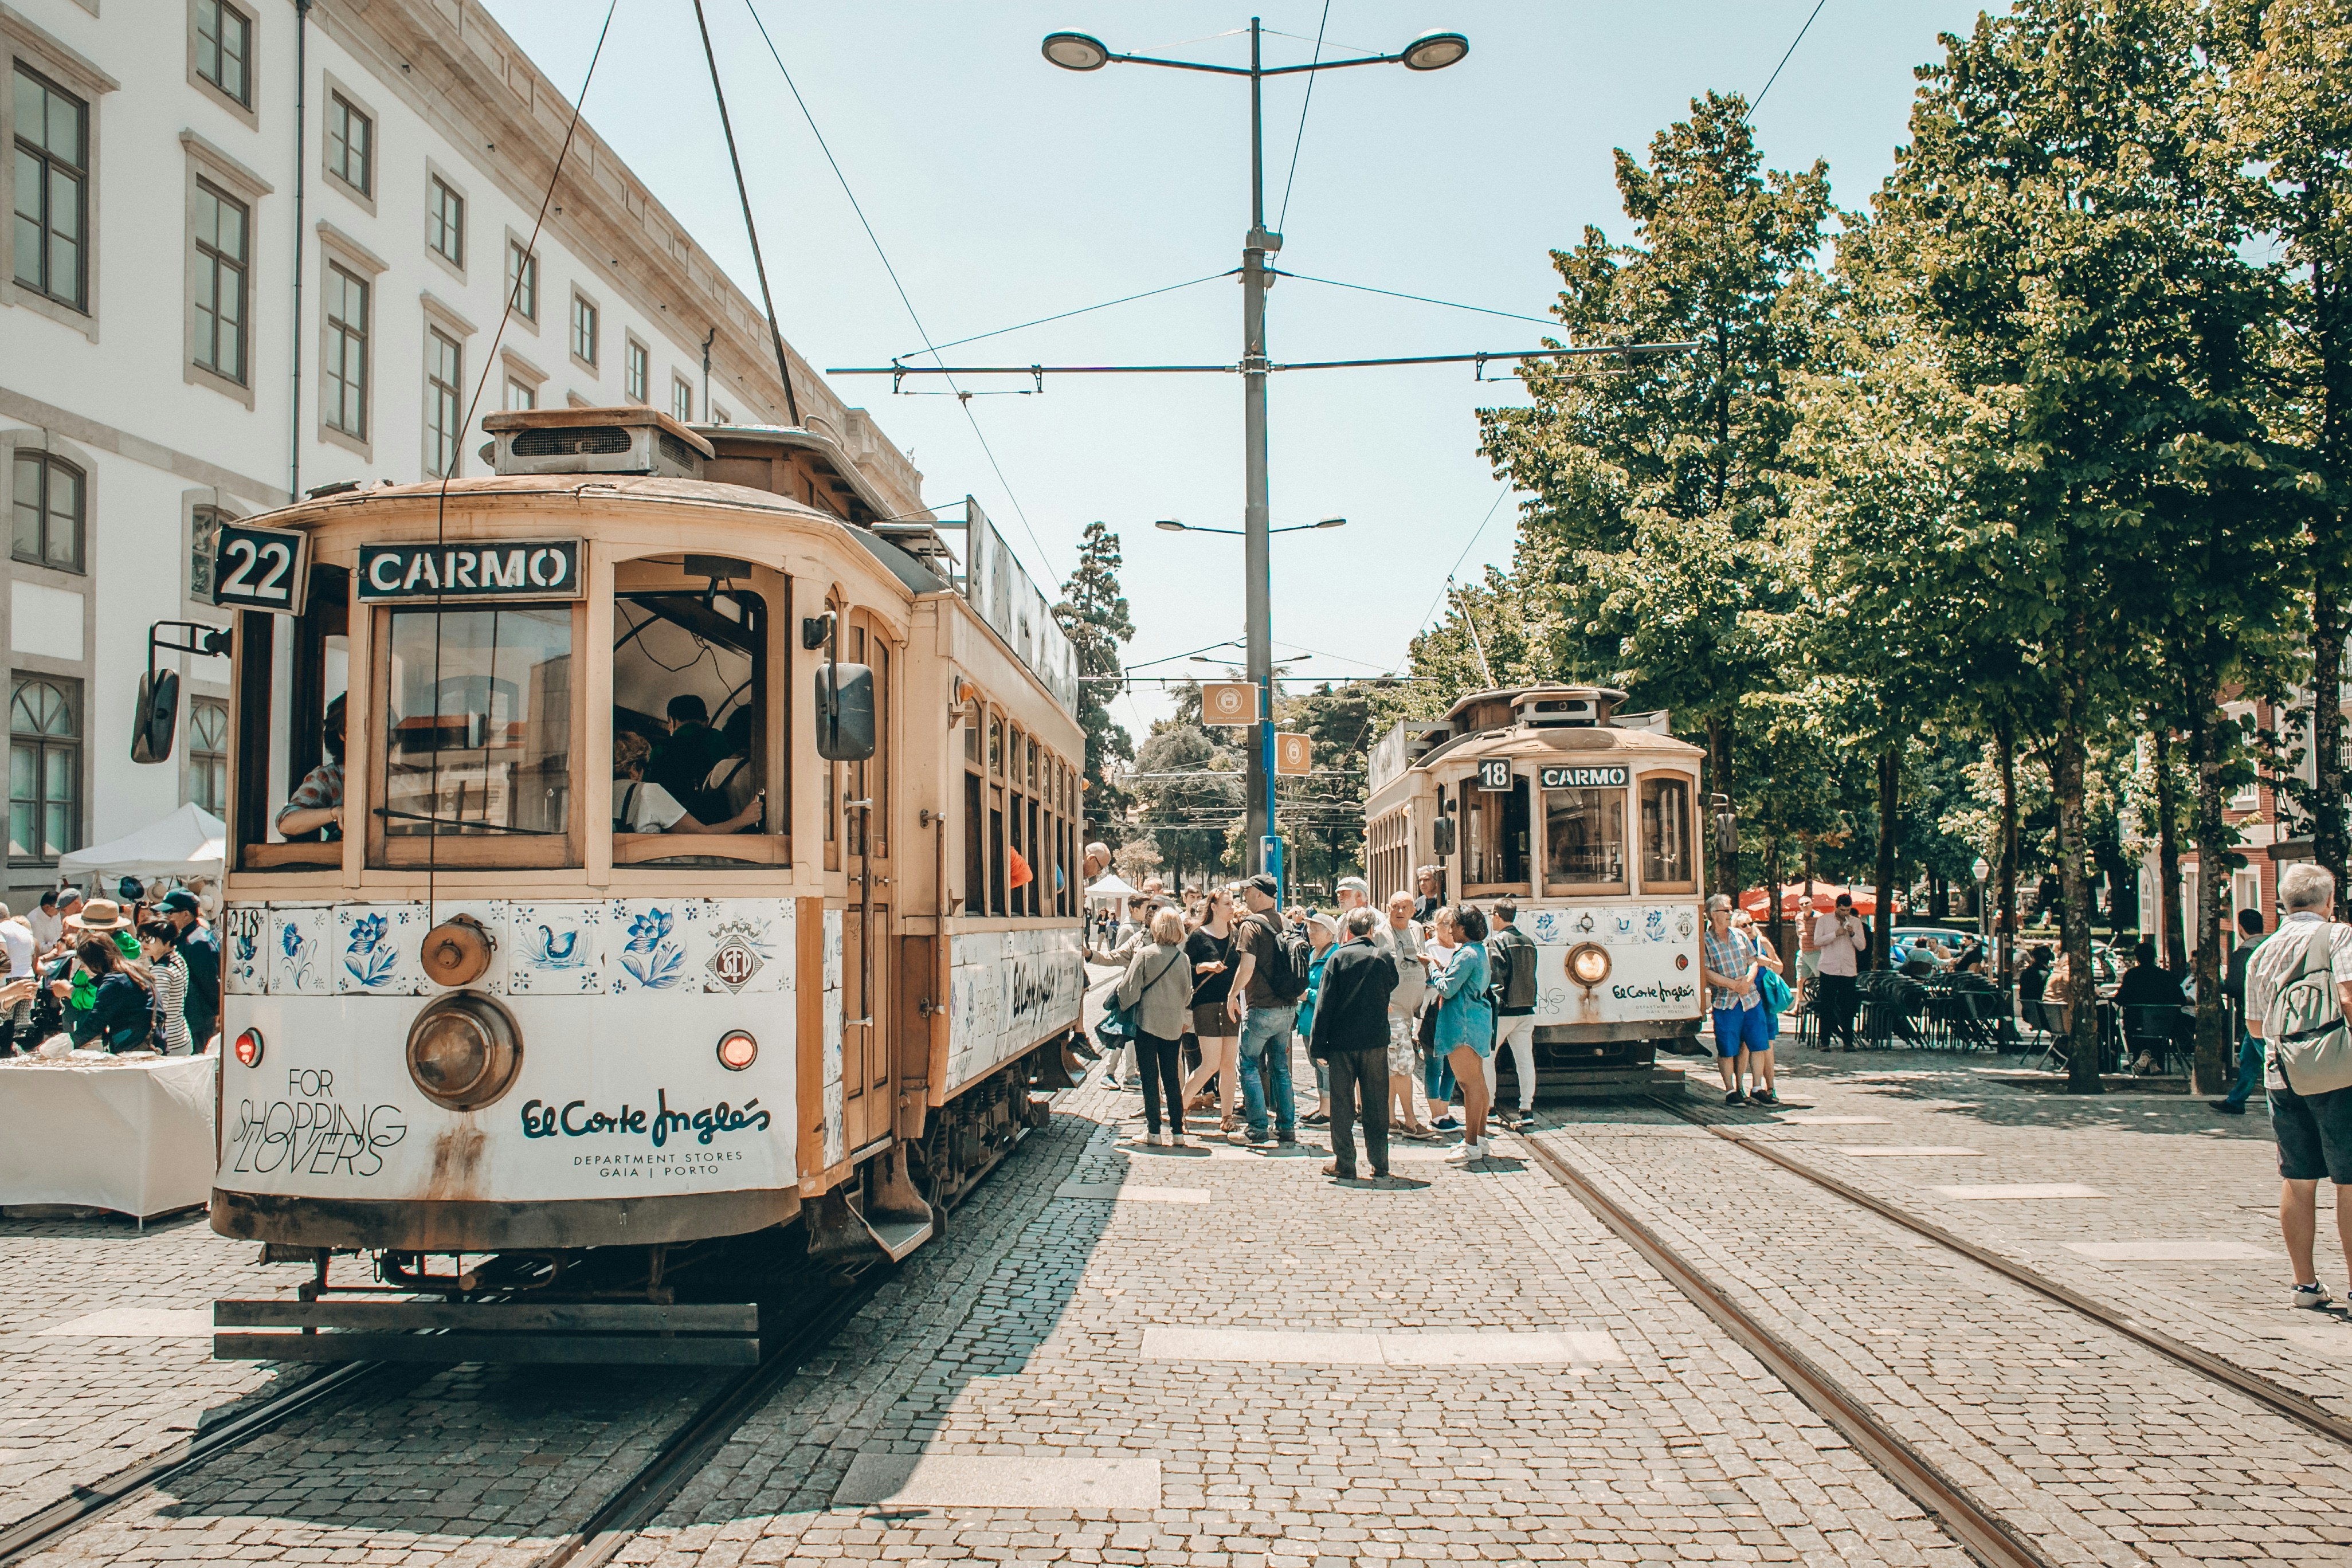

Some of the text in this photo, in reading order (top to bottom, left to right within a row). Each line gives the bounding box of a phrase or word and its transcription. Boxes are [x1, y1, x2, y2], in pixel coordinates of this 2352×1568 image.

[221, 539, 291, 599] 22
[369, 548, 567, 590] CARMO
[1481, 763, 1507, 786] 18
[1544, 769, 1625, 786] CARMO
[230, 910, 259, 937] 218
[1613, 985, 1627, 999] El
[1627, 985, 1658, 998] Corte
[289, 1069, 333, 1097] FOR
[233, 1099, 407, 1147] SHOPPING
[521, 1099, 558, 1139] El
[560, 1100, 647, 1137] Corte
[234, 1131, 383, 1176] LOVERS
[574, 1151, 742, 1166] DEPARTMENT STORES
[599, 1167, 639, 1178] GAIA
[665, 1165, 719, 1176] PORTO
